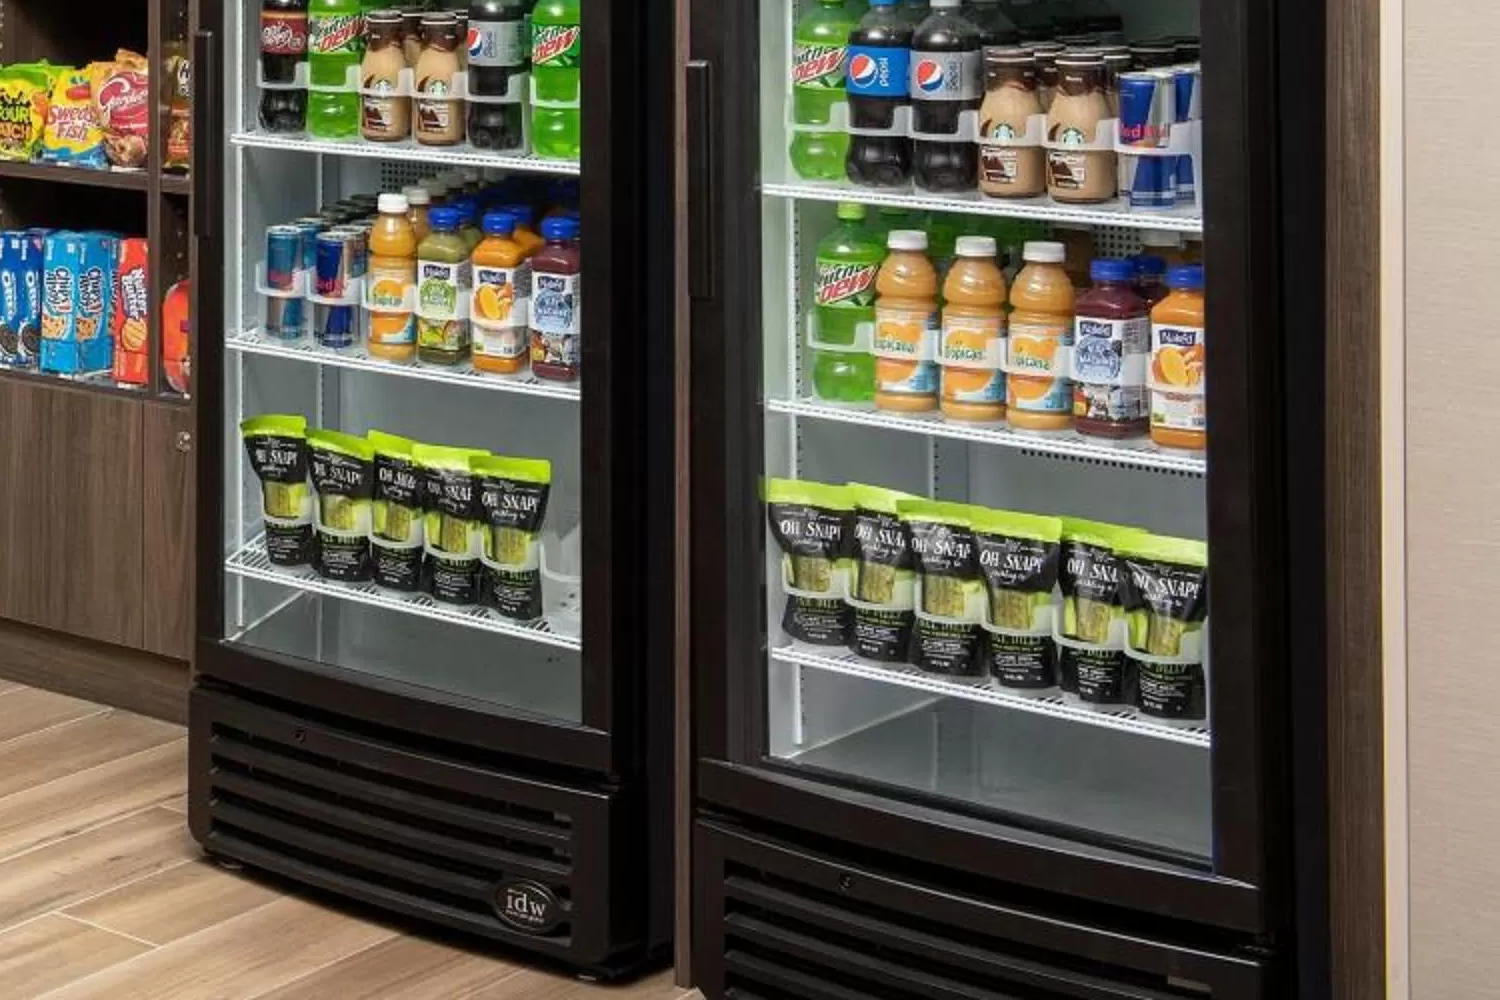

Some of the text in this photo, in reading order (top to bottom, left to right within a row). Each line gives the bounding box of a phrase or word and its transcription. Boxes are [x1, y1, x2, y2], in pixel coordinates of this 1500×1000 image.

[122, 274, 137, 319] Butter
[131, 267, 147, 316] Nutter
[1161, 331, 1195, 345] Naked
[979, 549, 1000, 567] OH
[1067, 559, 1120, 583] OH SNA
[1155, 576, 1200, 600] SNAP!
